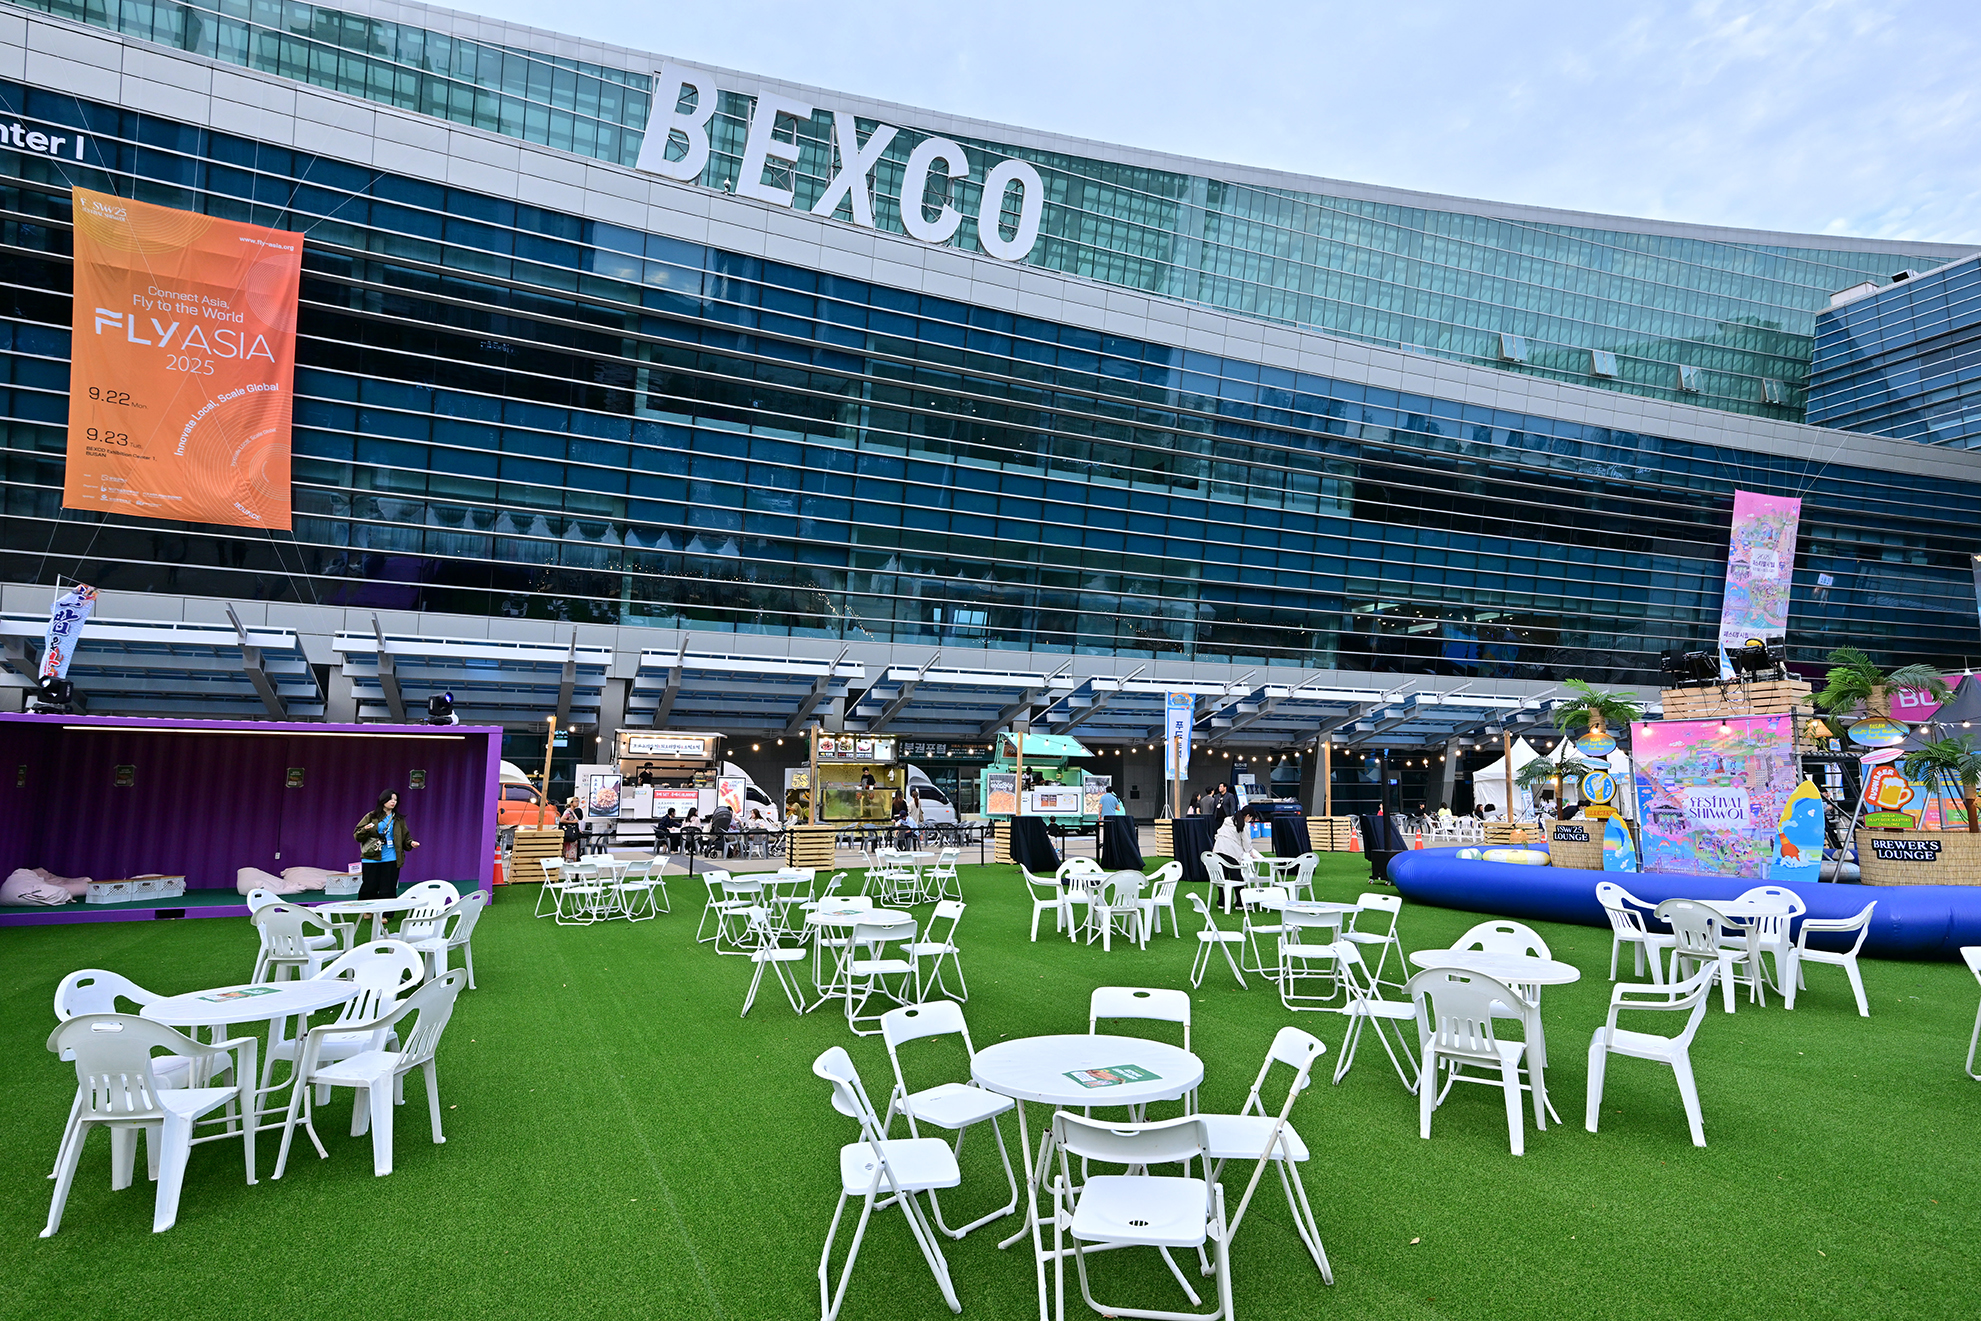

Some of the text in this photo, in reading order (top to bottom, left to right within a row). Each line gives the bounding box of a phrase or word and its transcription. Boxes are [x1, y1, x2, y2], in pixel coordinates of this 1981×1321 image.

[636, 60, 1044, 263] BEXCO
[239, 237, 294, 251] www.fly-asia.org
[148, 286, 198, 302] Connect
[133, 294, 244, 323] Fly to the World
[165, 354, 214, 375] 2025
[88, 386, 130, 406] 9.22
[174, 382, 279, 457] Innovate Local, Scale Global
[86, 427, 129, 446] 9.23
[233, 501, 262, 521] BOUNCE
[1876, 768, 1894, 781] BEER
[1690, 795, 1744, 808] FESTIVAL
[1689, 808, 1747, 820] SHIWOL
[1554, 832, 1588, 841] LOUNGE
[1873, 839, 1940, 850] BREWER'S
[1878, 850, 1935, 860] LOUNGE
